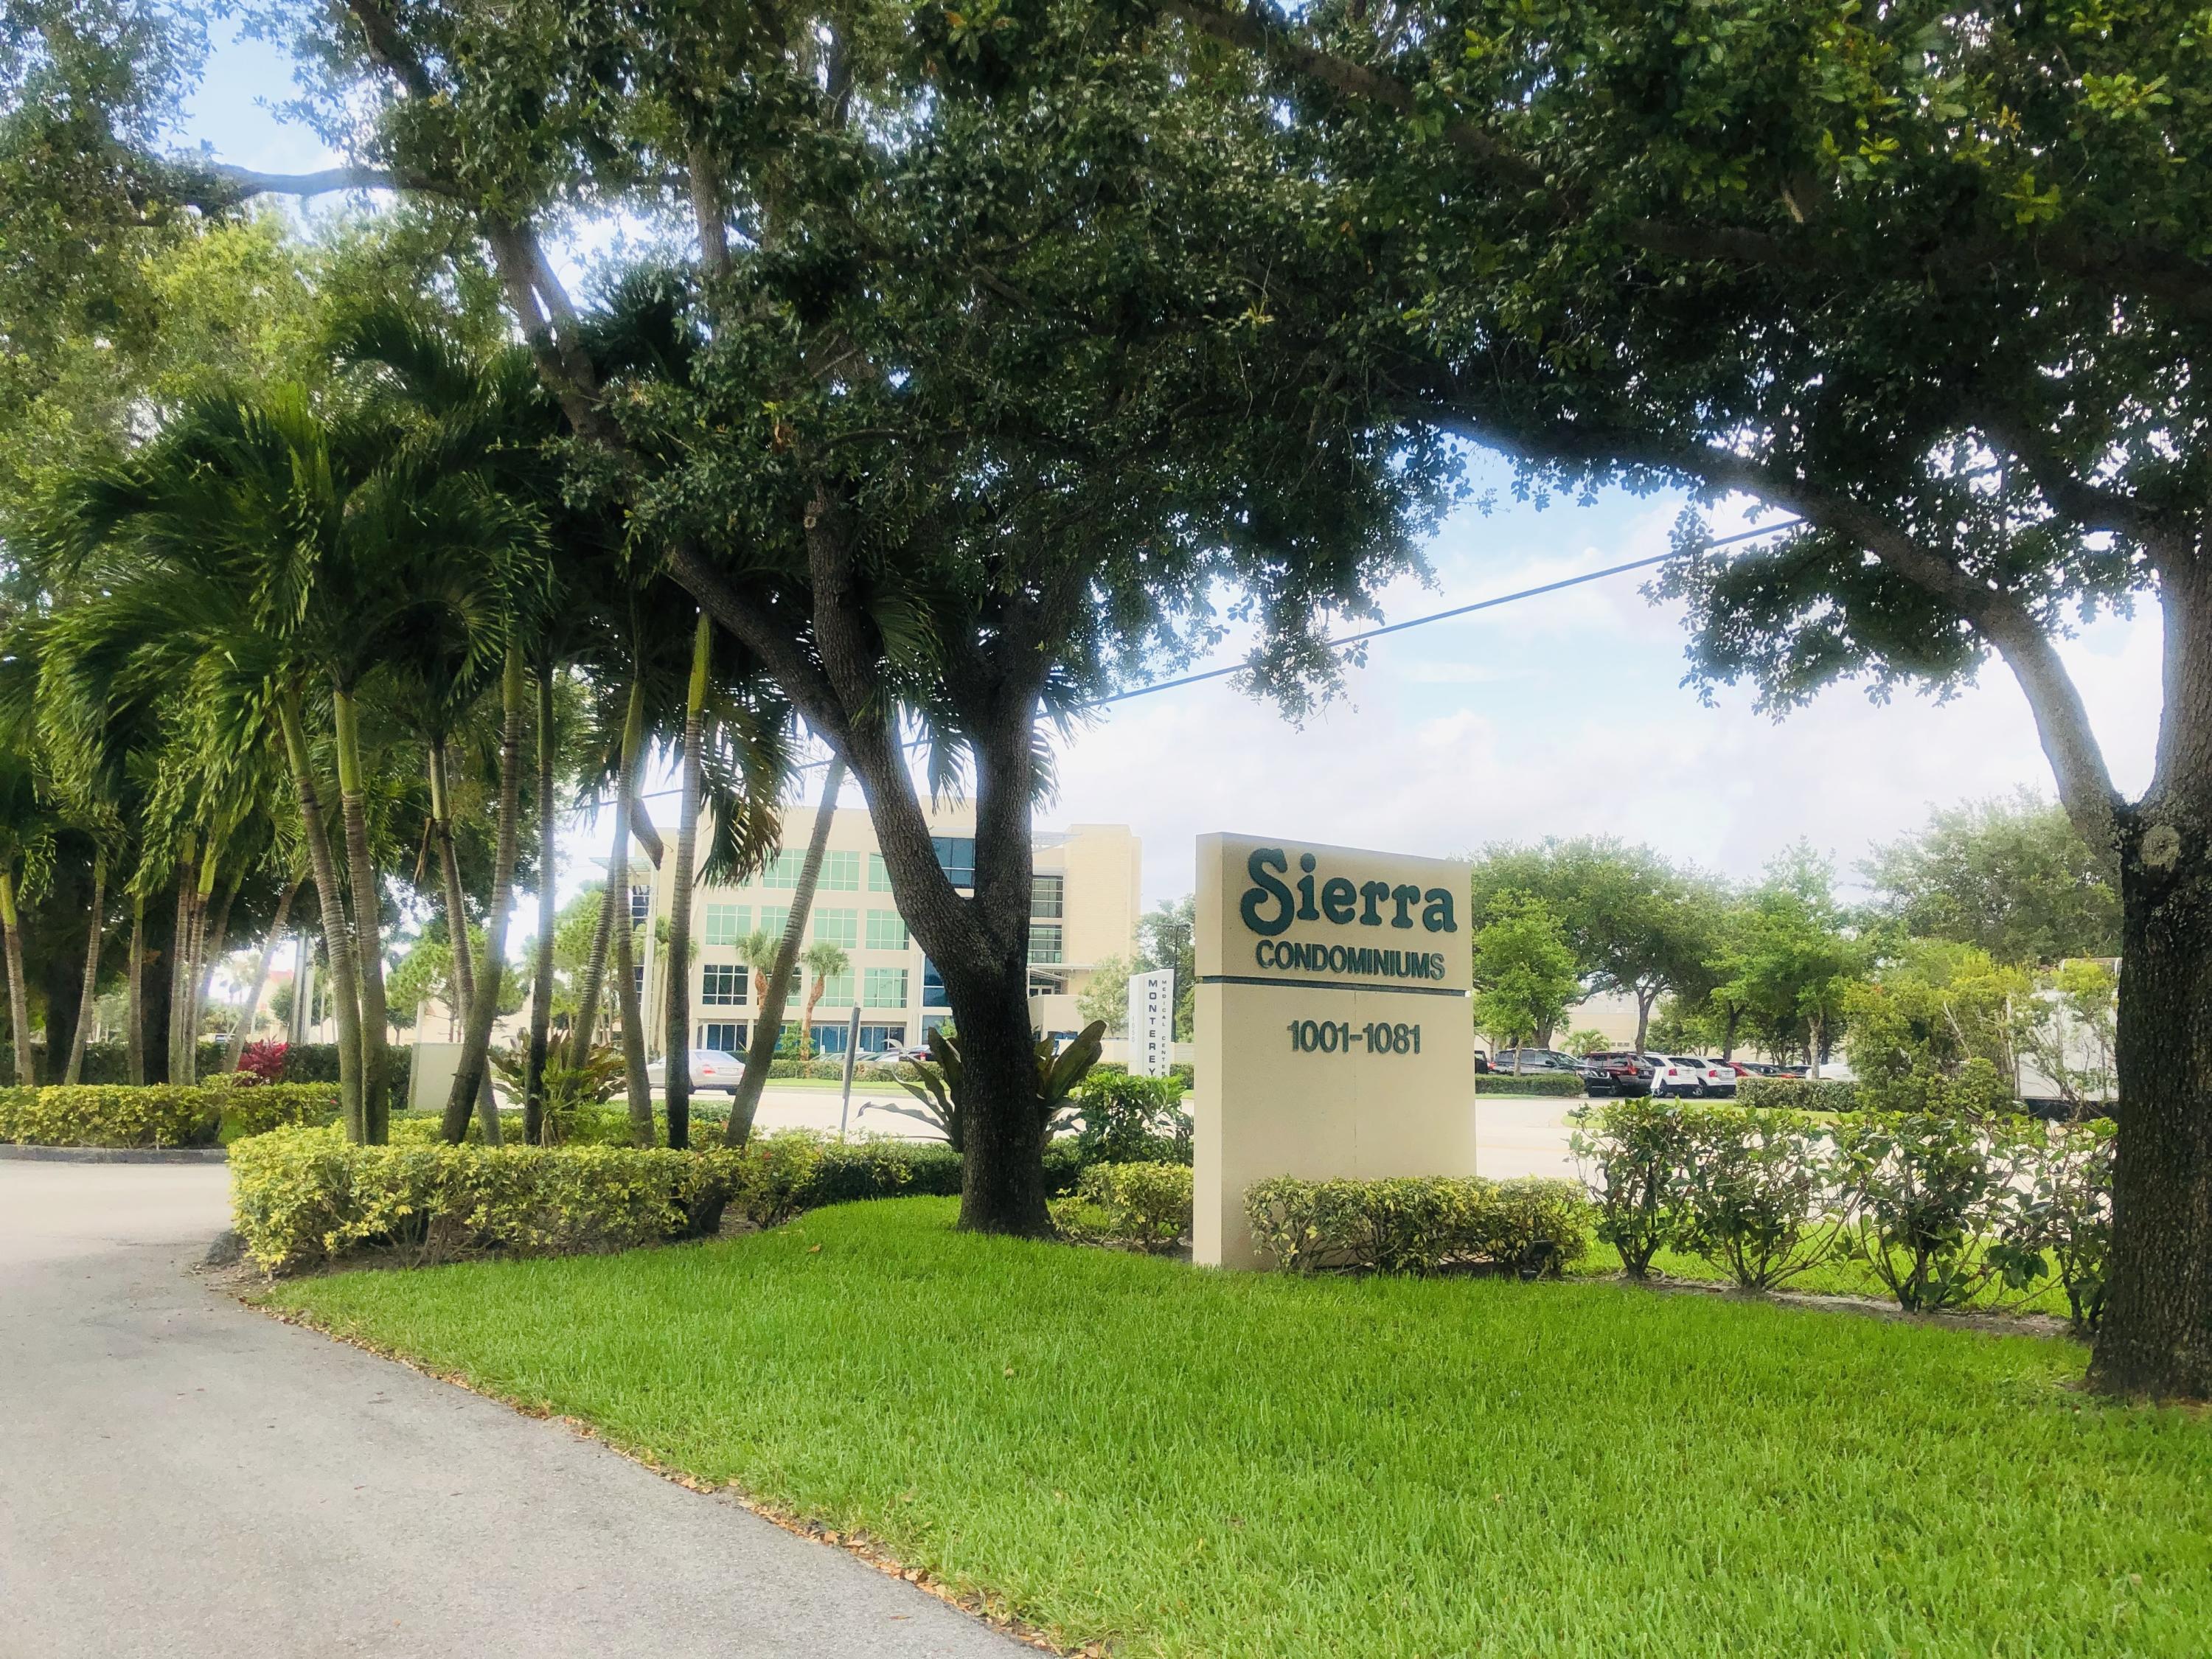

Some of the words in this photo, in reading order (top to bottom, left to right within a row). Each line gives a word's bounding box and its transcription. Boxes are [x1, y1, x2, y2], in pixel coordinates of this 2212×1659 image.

[1240, 848, 1458, 936] Sierra
[1256, 939, 1445, 981] CONDOMINIUMS
[1148, 979, 1158, 1076] MONTEREY
[1287, 1020, 1421, 1054] 1001-1081
